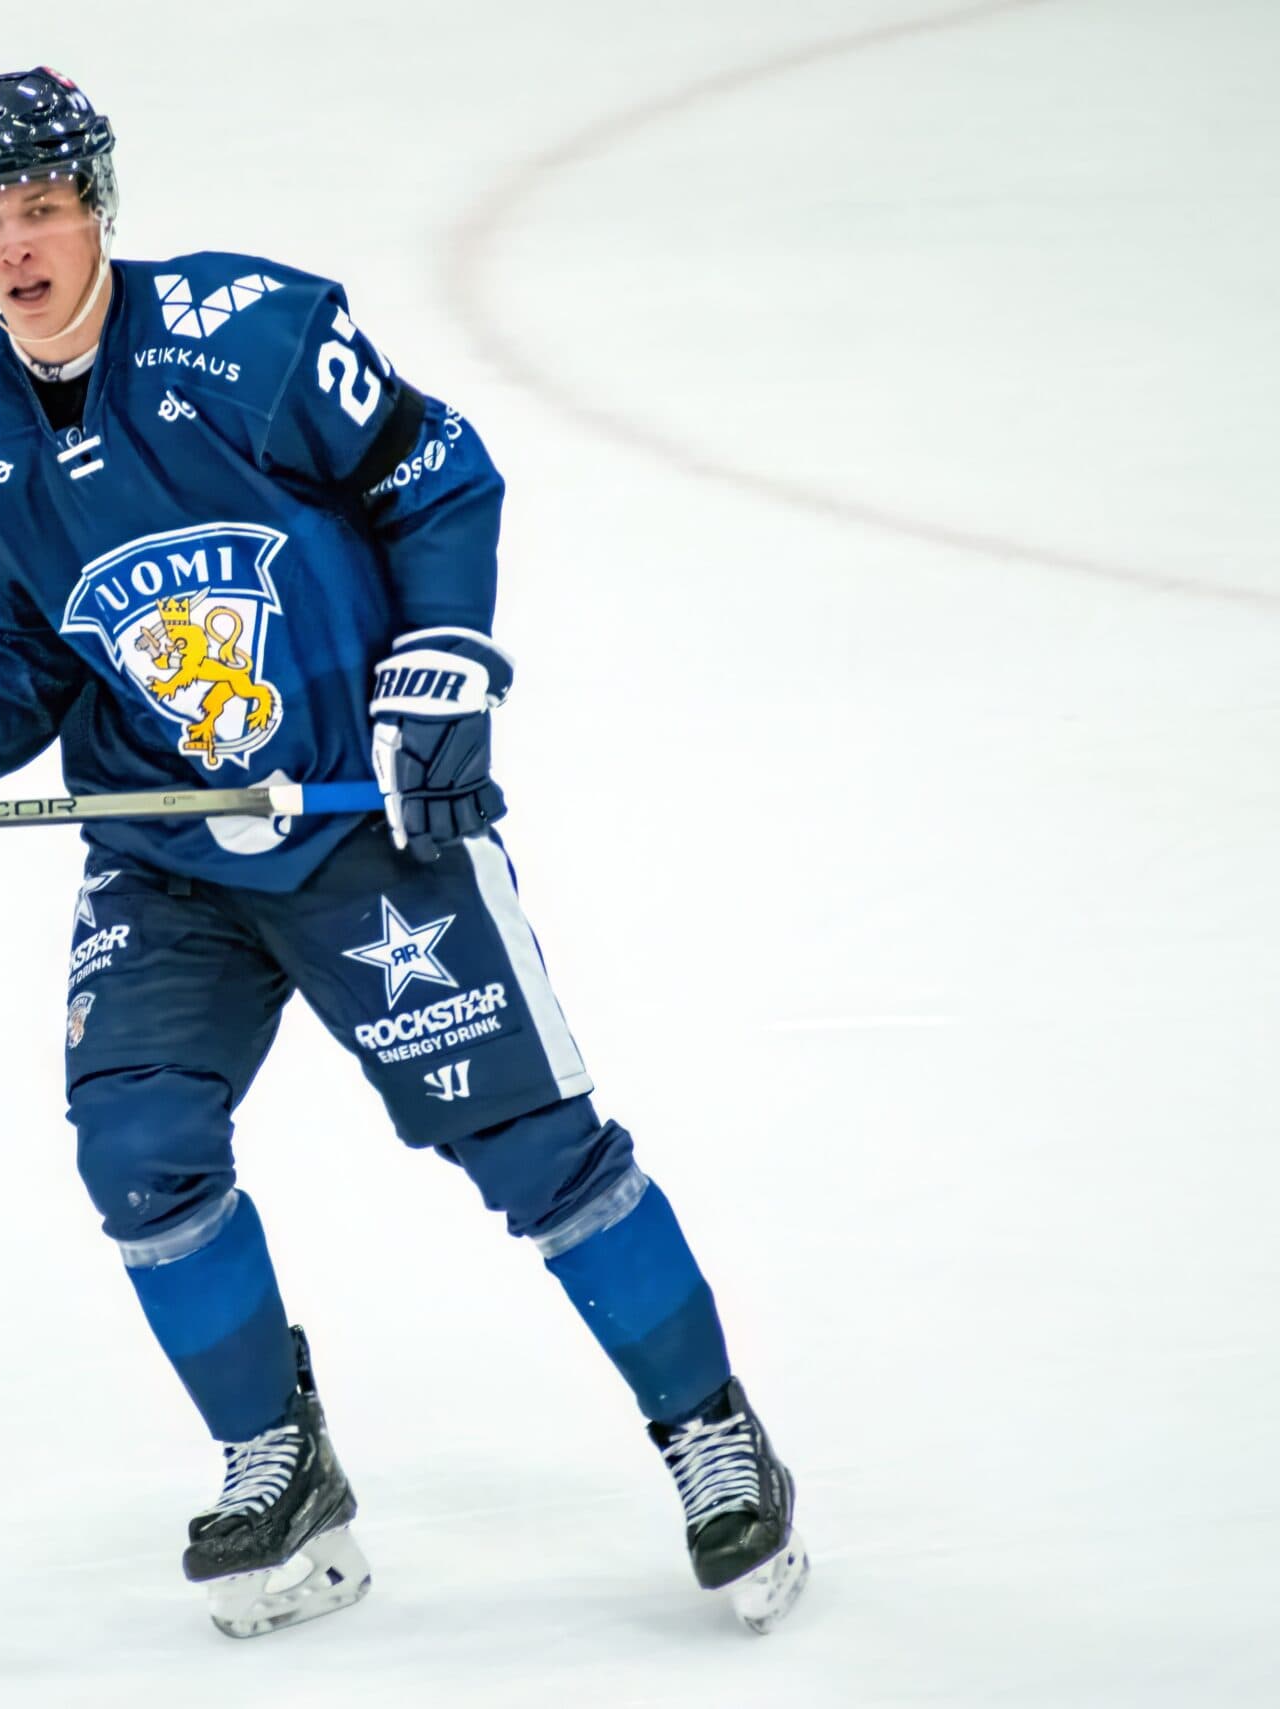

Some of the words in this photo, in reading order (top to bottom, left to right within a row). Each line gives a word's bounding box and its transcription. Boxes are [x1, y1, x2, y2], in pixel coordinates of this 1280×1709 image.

[134, 347, 240, 382] VEIKKAUS
[94, 546, 233, 611] UOMI
[355, 982, 508, 1050] ROCKSTAR
[377, 1035, 442, 1064] ENERGY
[444, 1015, 502, 1046] DRINK
